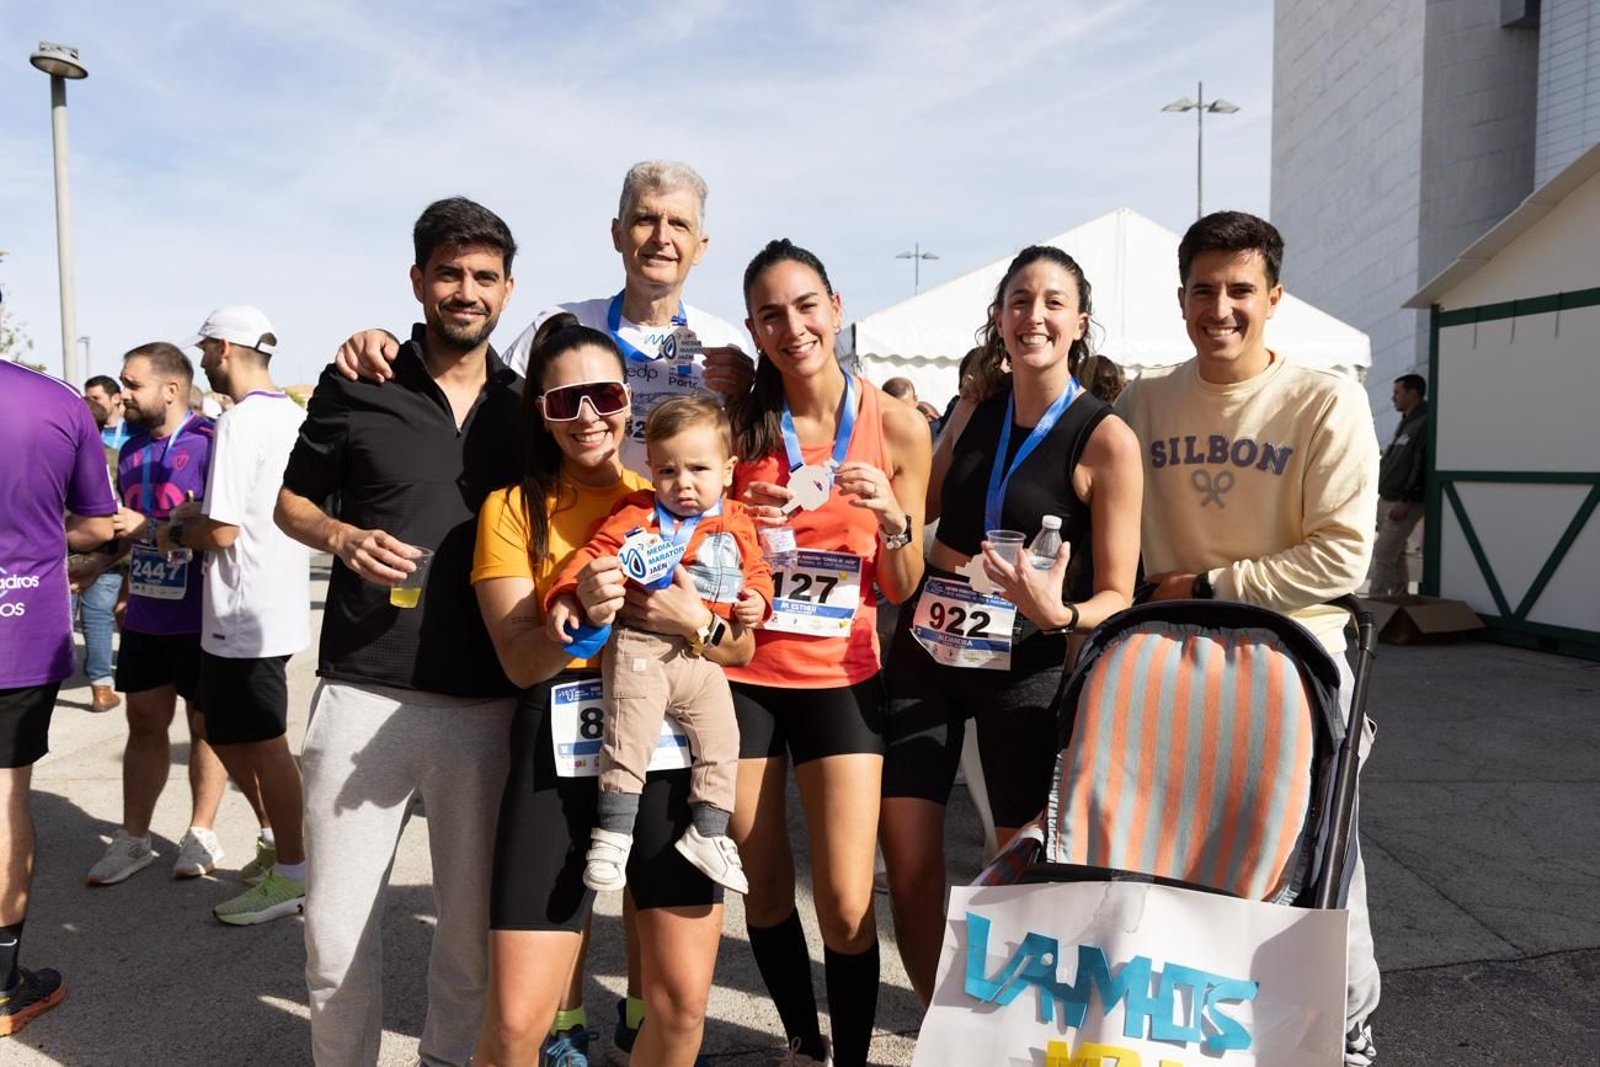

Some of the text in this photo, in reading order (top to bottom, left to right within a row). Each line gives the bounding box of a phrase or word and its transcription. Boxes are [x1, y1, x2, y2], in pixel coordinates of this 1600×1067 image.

[626, 364, 658, 382] edp
[1150, 434, 1293, 476] SILBON
[646, 541, 671, 556] MEDIA
[132, 559, 180, 581] 2447
[771, 571, 838, 604] 127
[929, 602, 991, 638] 922
